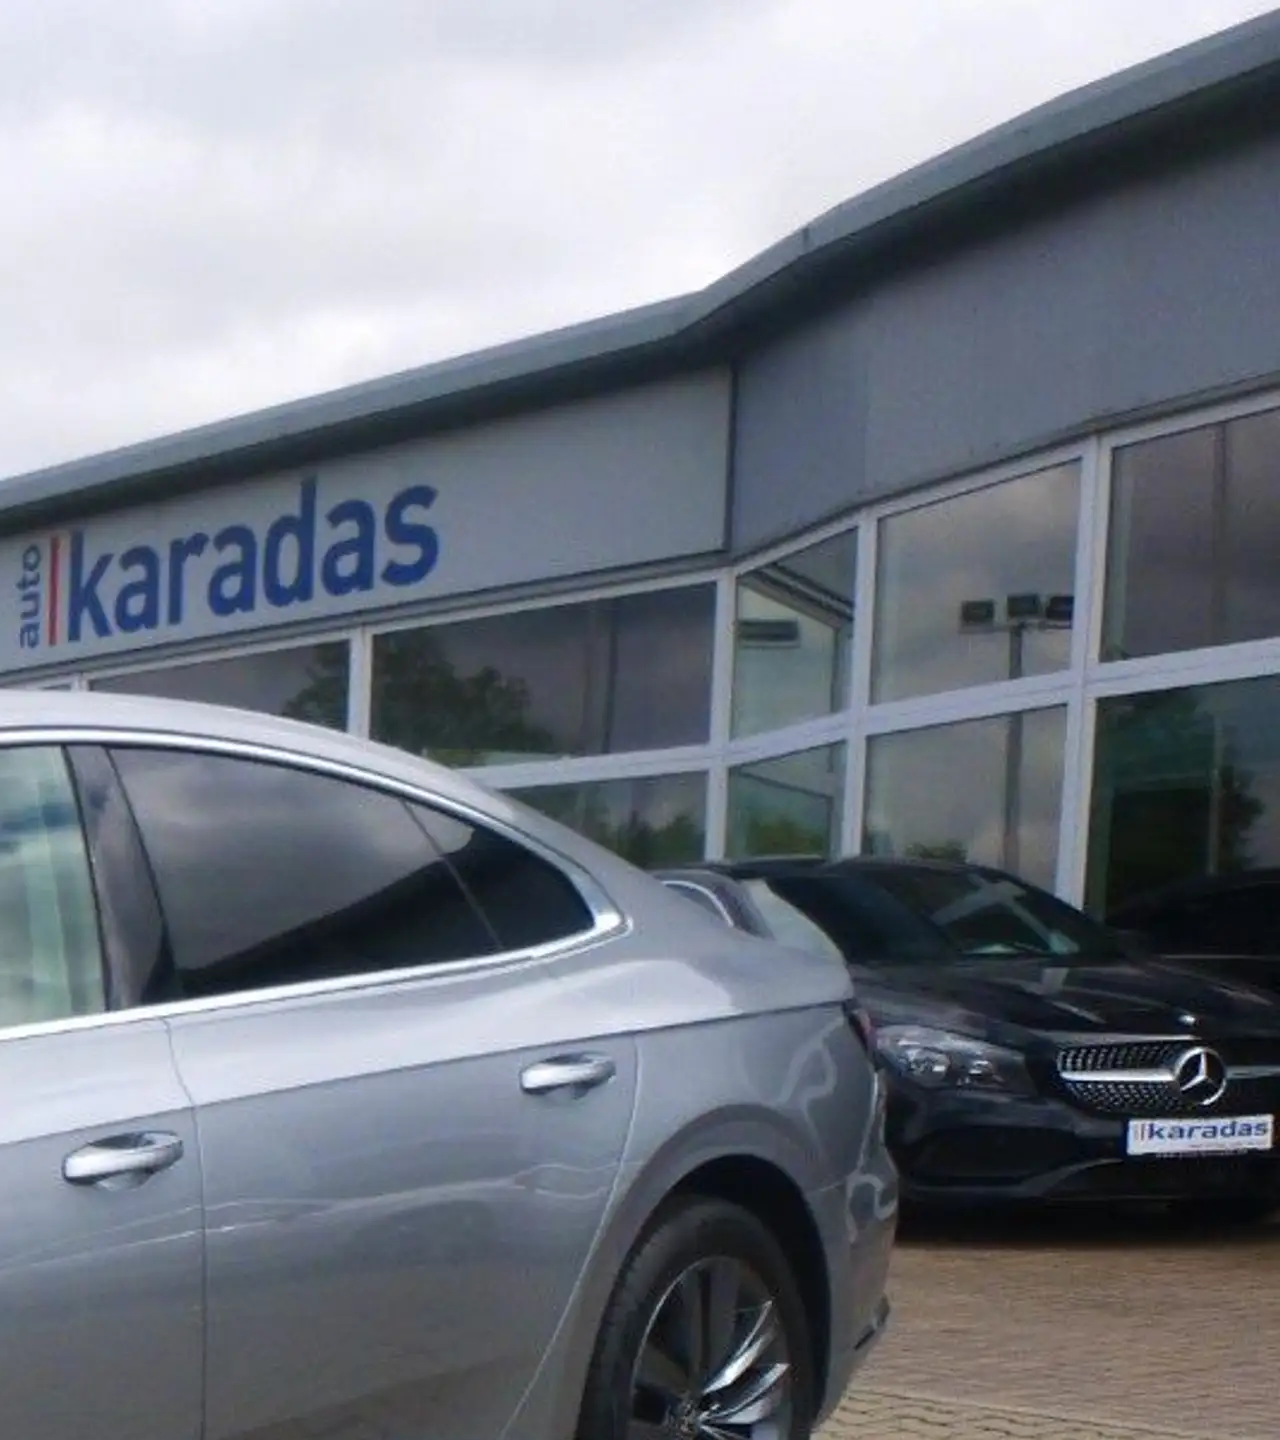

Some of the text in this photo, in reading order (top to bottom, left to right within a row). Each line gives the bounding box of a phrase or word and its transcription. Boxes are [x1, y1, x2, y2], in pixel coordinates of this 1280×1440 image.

[16, 476, 438, 649] auto karadas
[1148, 1121, 1268, 1140] karadas
